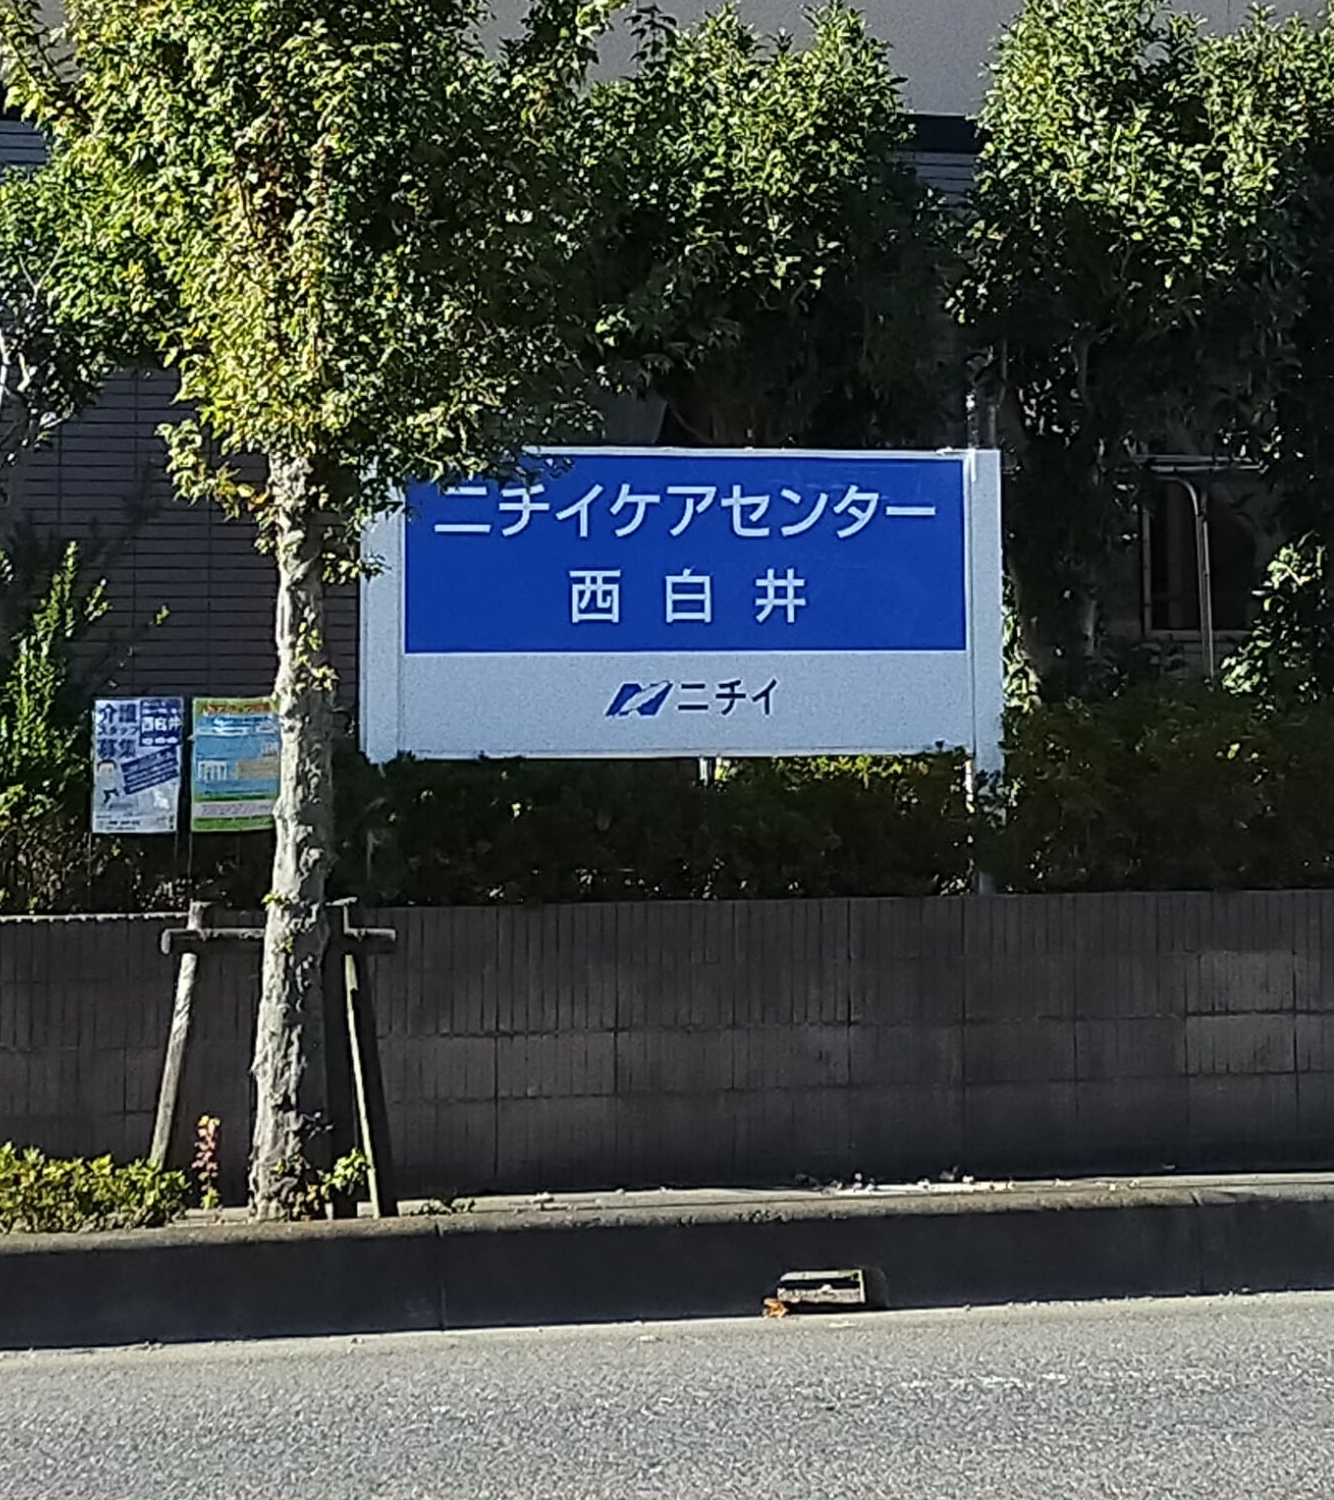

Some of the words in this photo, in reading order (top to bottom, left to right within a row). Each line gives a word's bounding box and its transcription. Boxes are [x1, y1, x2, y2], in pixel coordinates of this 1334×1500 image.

[434, 483, 937, 538] ニチイケアセンター
[569, 568, 806, 623] 西白井
[677, 679, 777, 716] ニチイ
